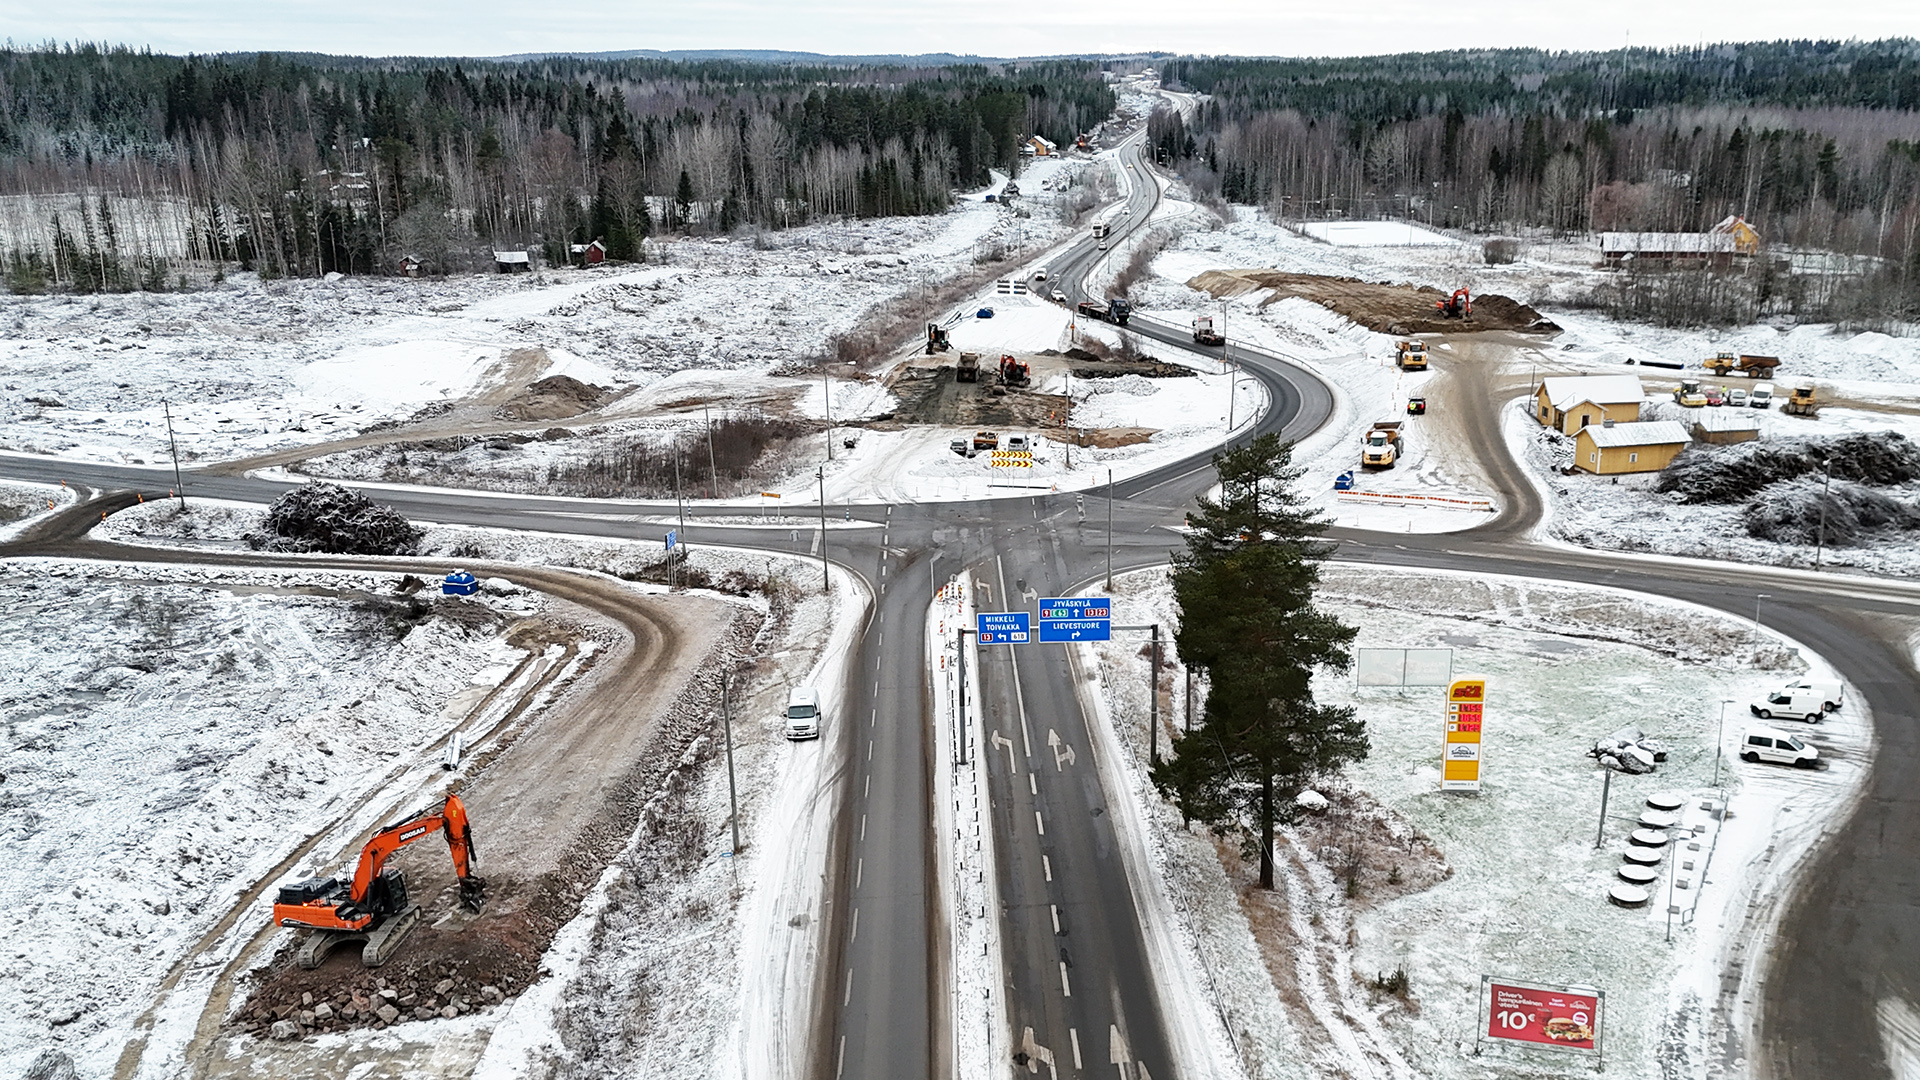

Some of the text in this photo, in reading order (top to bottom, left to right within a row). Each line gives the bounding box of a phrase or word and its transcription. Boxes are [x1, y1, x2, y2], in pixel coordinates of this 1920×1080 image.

[1053, 599, 1091, 607] JYVÄSKYLÄ
[1099, 609, 1107, 617] 23
[985, 615, 1015, 623] MIKKELI
[986, 623, 1020, 631] TOIVAKKA
[1053, 622, 1100, 630] LIEVESTUORE
[400, 826, 425, 840] DOOSAN
[1498, 990, 1523, 999] Driver's
[1498, 996, 1543, 1007] hampurilainen
